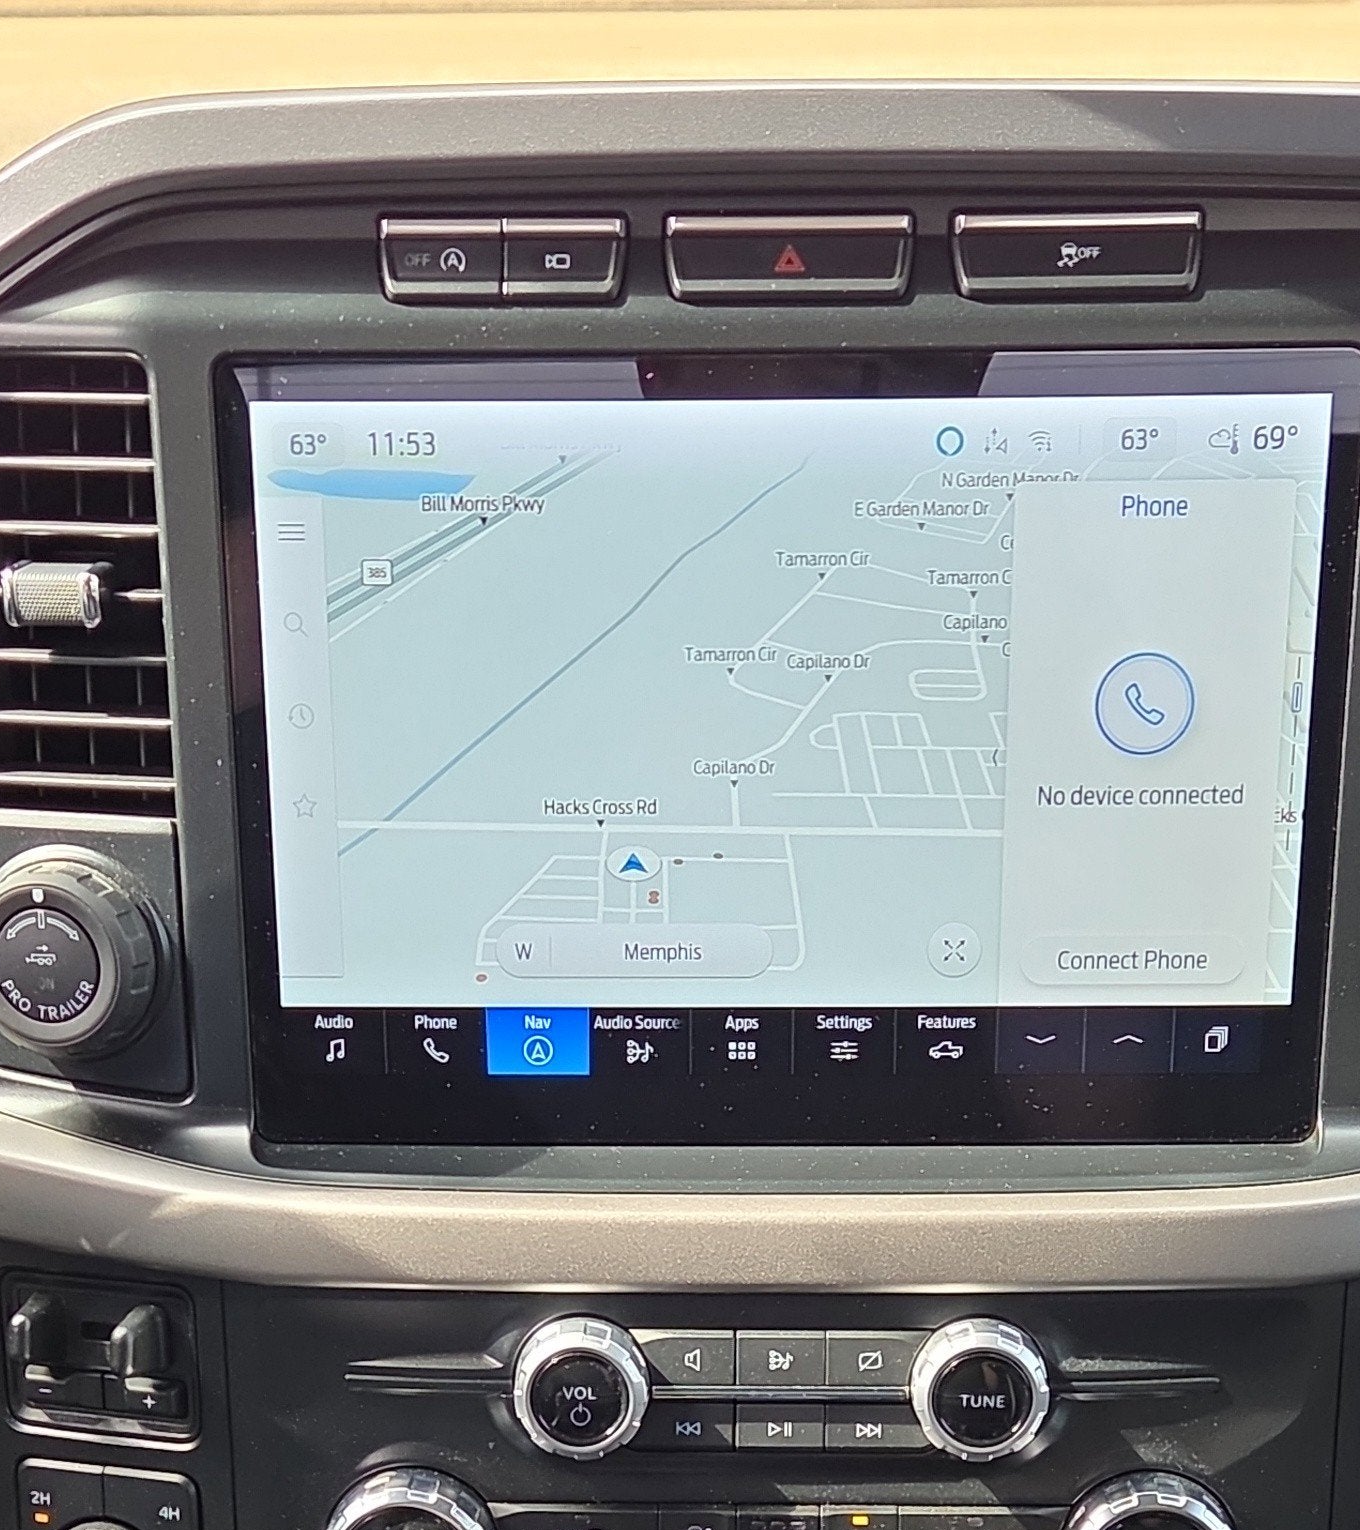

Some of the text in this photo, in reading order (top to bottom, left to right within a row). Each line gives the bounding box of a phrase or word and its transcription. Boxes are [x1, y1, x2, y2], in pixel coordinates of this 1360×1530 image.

[367, 430, 437, 456] 11:53
[941, 472, 953, 487] N
[955, 472, 1010, 487] Garden
[421, 496, 545, 515] Bill Morris Pkwy
[854, 501, 989, 516] E Garden Manor Dr
[1121, 496, 1189, 517] Phone
[776, 551, 870, 567] Tamarron Cir
[927, 570, 997, 586] Tamarron
[943, 614, 1007, 632] Capilano
[684, 646, 778, 663] Tamarron Cir
[787, 654, 870, 672] Capilano Dr
[693, 760, 775, 777] Capilano Dr
[1037, 784, 1244, 806] No device connected
[543, 798, 658, 815] Hacks Cross Rd
[514, 942, 703, 964] W Memphis
[1056, 950, 1208, 971] Connect Phone
[0, 979, 95, 1021] PRO TRAILER
[314, 1014, 354, 1031] Audio
[414, 1014, 458, 1031] Phone
[524, 1014, 552, 1030] Nav
[593, 1014, 632, 1031] Audio
[725, 1014, 760, 1033] Apps
[816, 1014, 873, 1033] Settings
[917, 1014, 977, 1030] Features
[562, 1386, 597, 1401] VOL
[959, 1394, 1006, 1410] TUNE
[29, 1491, 51, 1506] 2H
[158, 1506, 181, 1521] 4H
